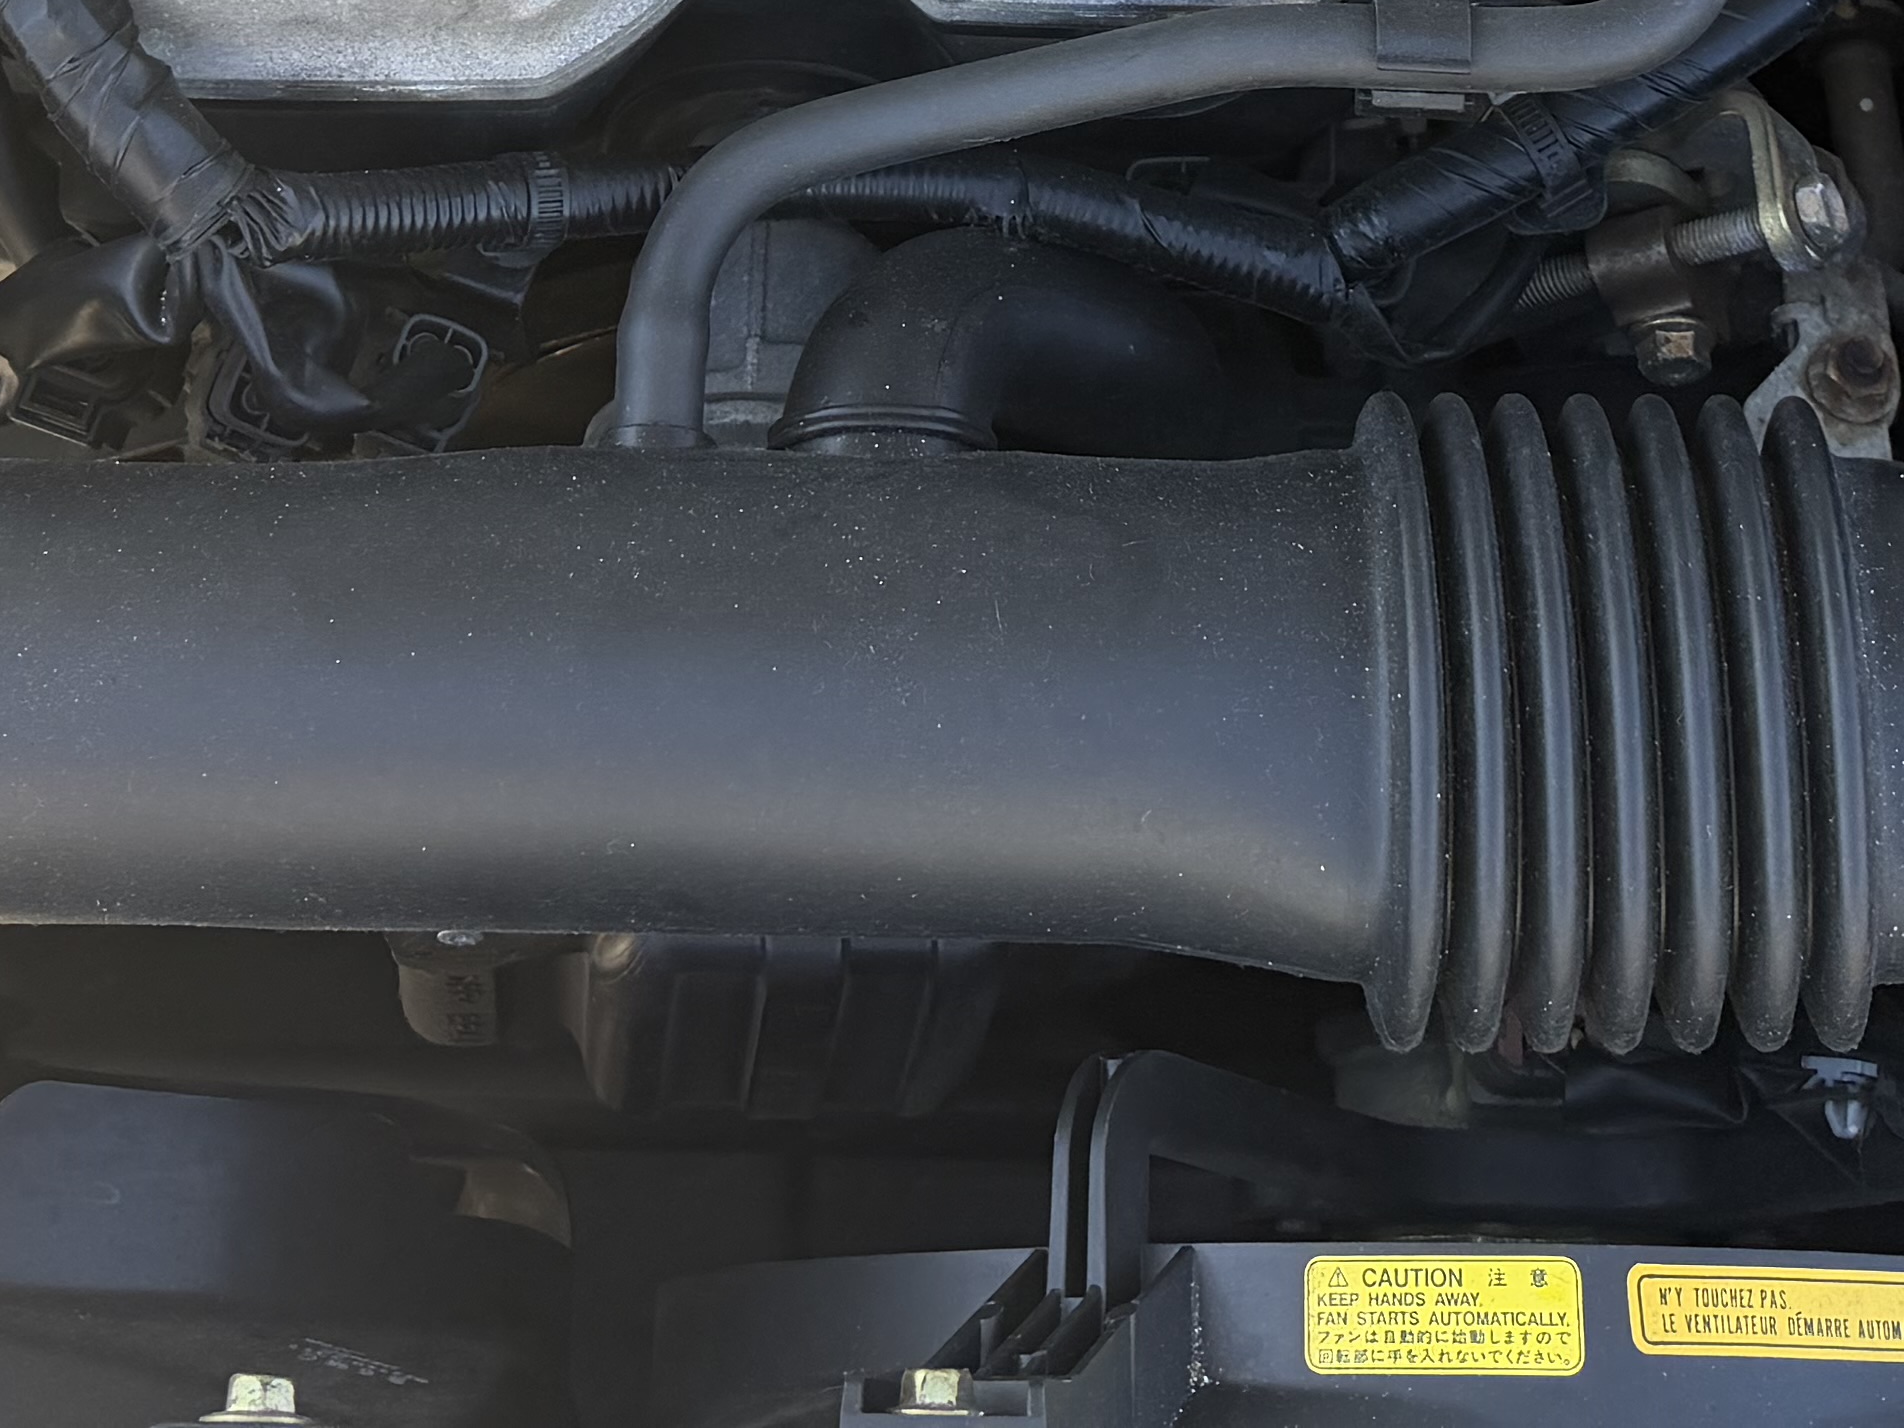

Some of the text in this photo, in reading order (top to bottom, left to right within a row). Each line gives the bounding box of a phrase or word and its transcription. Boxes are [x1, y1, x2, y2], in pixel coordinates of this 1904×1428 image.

[1362, 1268, 1463, 1288] CAUTION
[1317, 1293, 1483, 1307] KEEP HANDS AWAY.
[1694, 1288, 1754, 1309] TOUCHEZ
[1760, 1289, 1792, 1310] PAS.
[1317, 1312, 1570, 1326] FAN STARTS AUTOMATICALLY.
[1662, 1313, 1678, 1334] LE
[1685, 1314, 1777, 1337] VENTILATEUR
[1788, 1312, 1851, 1338] DÉMARRE
